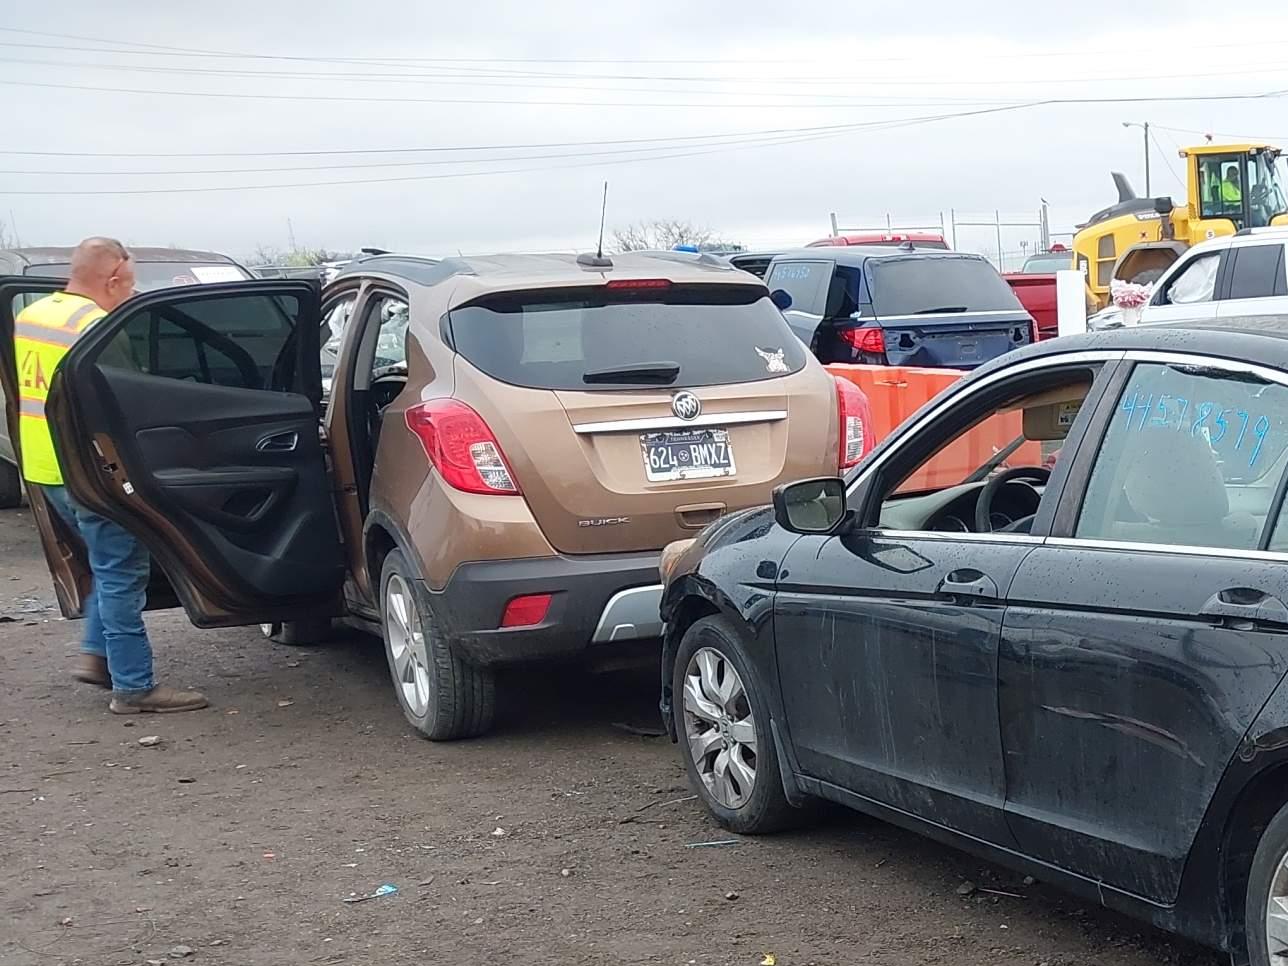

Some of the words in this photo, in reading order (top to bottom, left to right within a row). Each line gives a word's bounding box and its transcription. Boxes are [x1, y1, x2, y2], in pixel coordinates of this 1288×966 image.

[1121, 392, 1271, 467] 44578579
[649, 446, 678, 468] 624
[689, 443, 729, 466] BMXZ
[578, 516, 632, 528] BUICK
